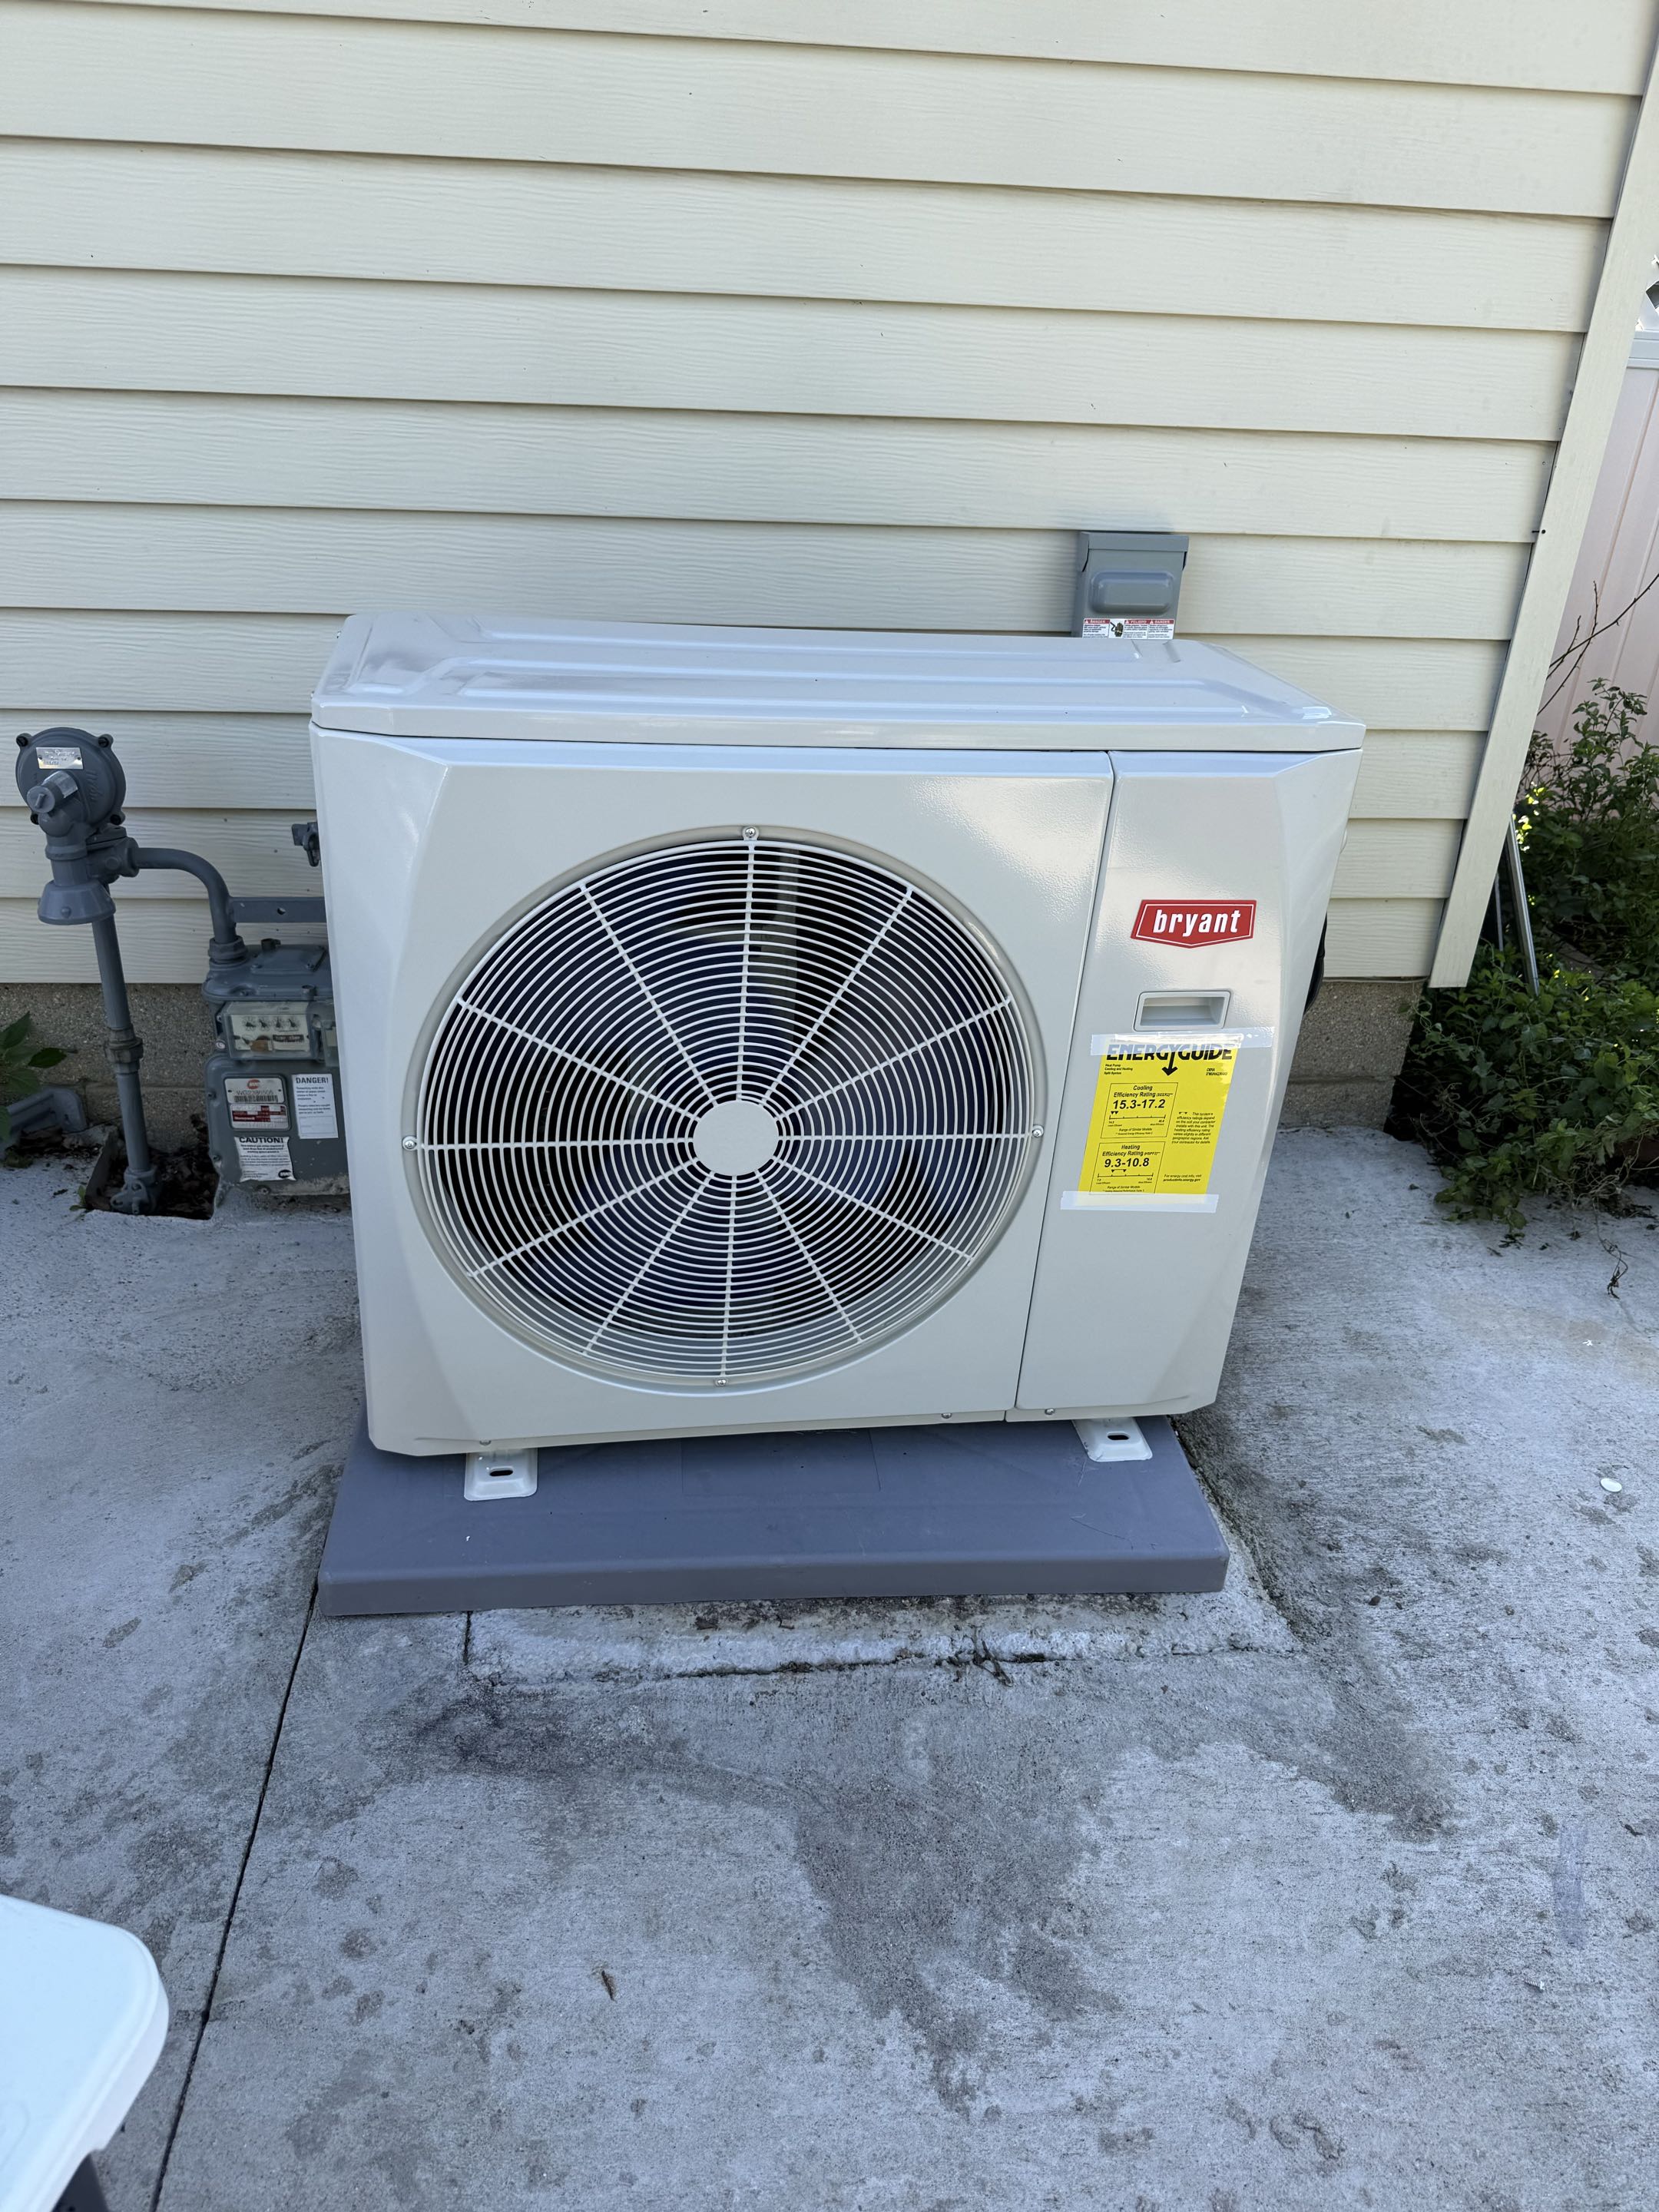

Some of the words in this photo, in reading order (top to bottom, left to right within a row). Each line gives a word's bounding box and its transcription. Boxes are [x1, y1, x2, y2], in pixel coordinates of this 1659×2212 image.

[1153, 909, 1240, 937] bryant
[1113, 1099, 1166, 1109] 15.3-17.2
[1104, 1158, 1149, 1168] 9.3-10.8
